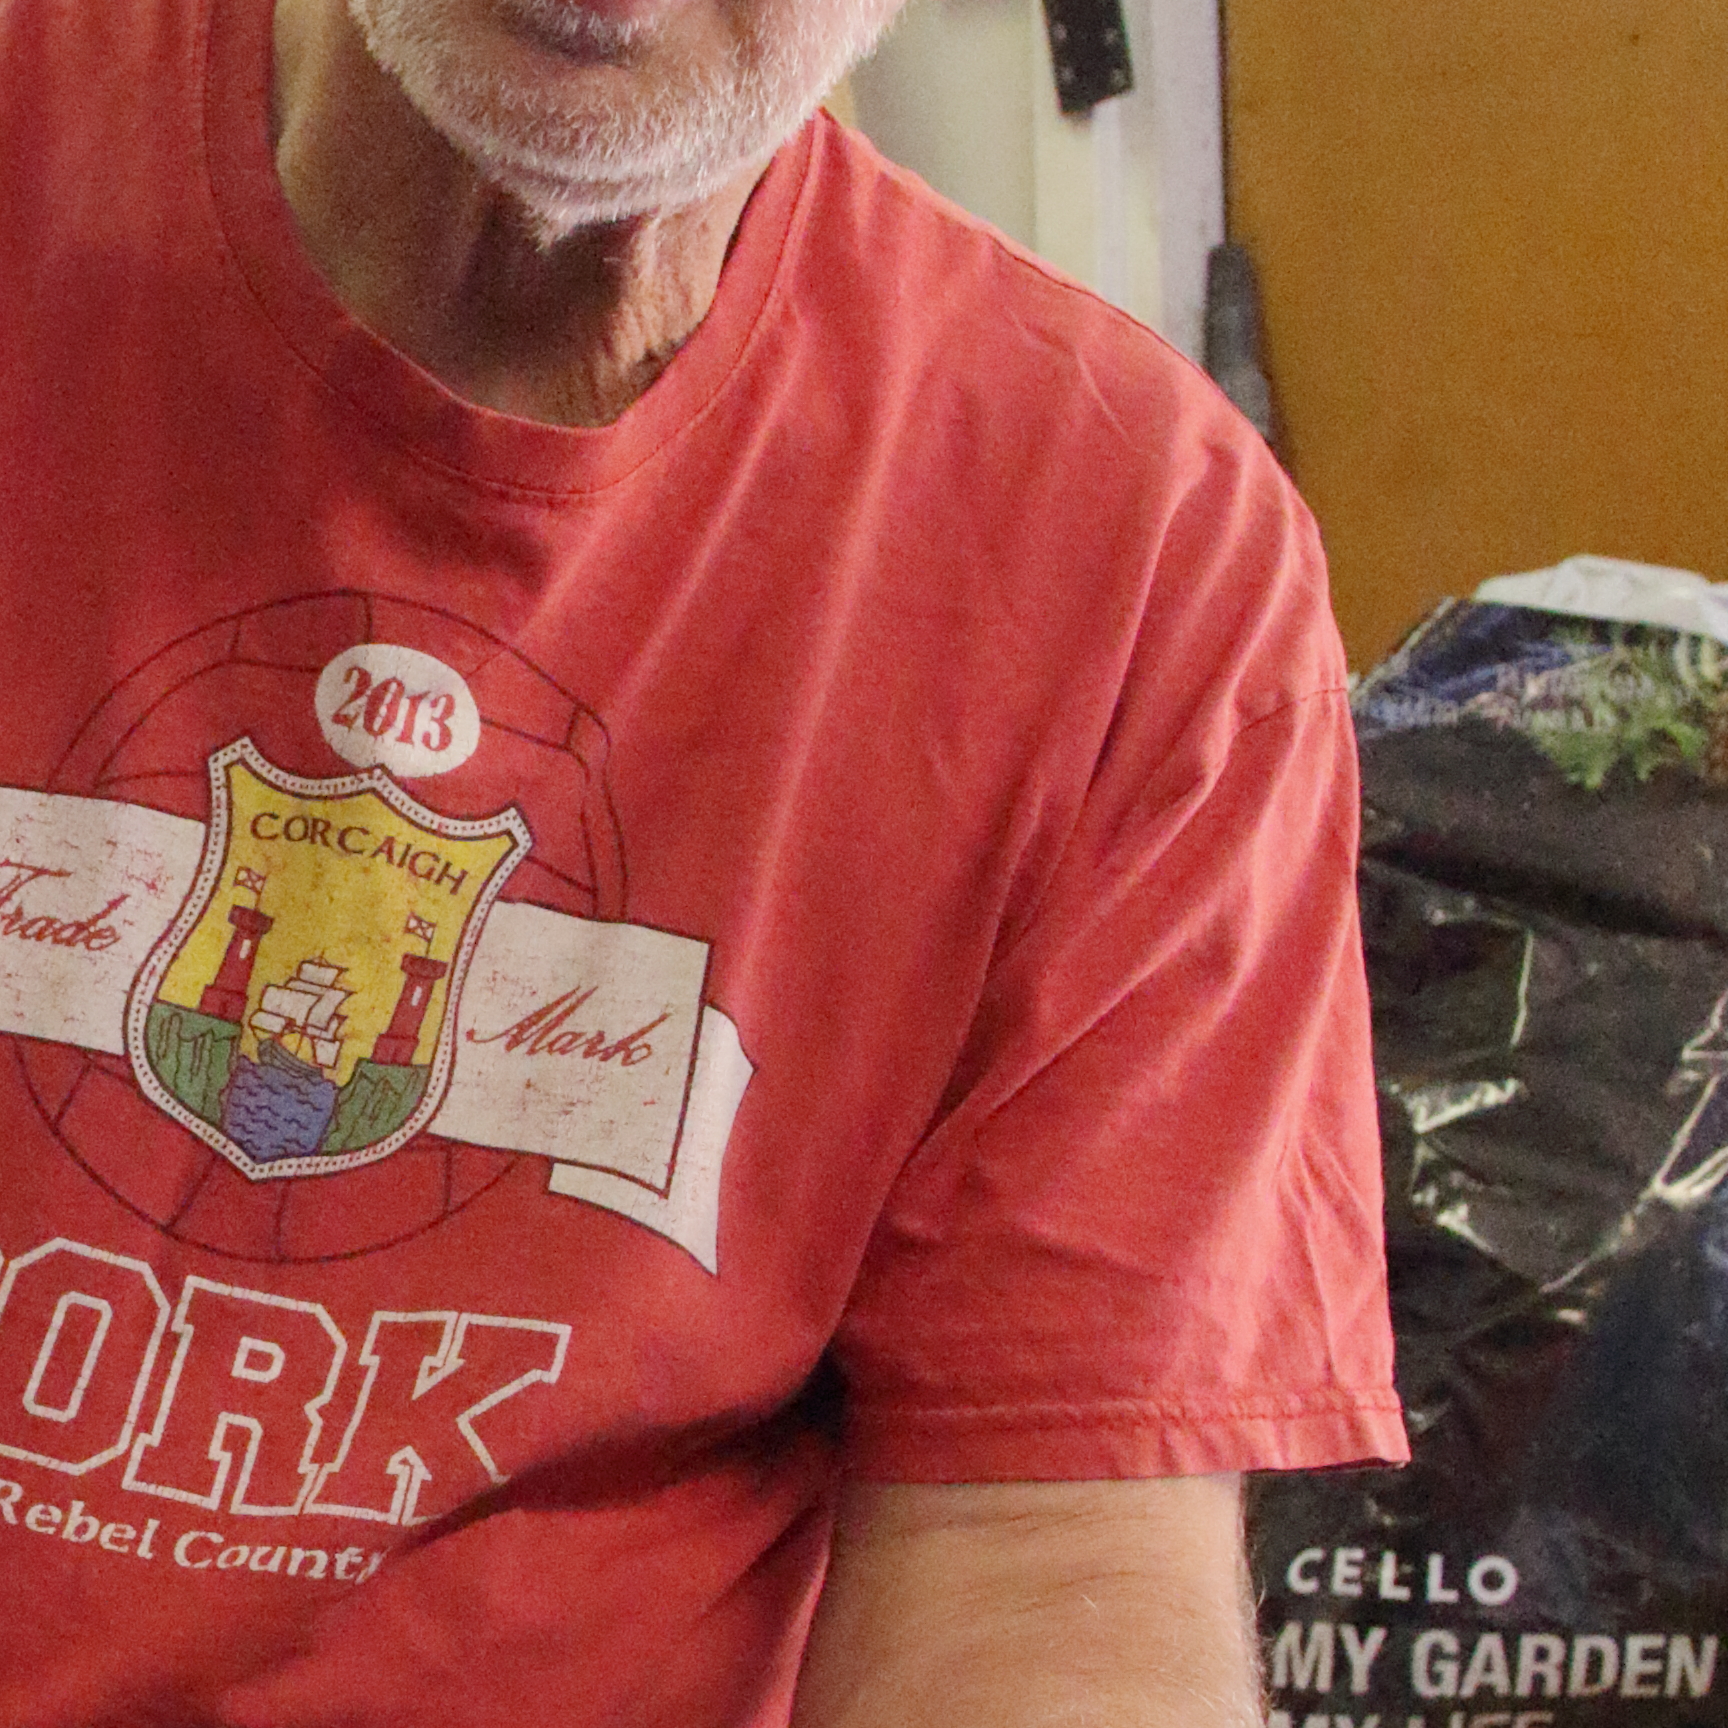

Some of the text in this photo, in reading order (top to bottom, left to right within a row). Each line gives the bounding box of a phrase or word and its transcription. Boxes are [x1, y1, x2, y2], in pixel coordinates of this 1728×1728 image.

[327, 665, 456, 754] 2013
[250, 810, 469, 896] CORCAIGH
[465, 986, 656, 1068] Mark
[1286, 1547, 1519, 1606] CELLO
[1273, 1621, 1719, 1699] MY GARDEN
